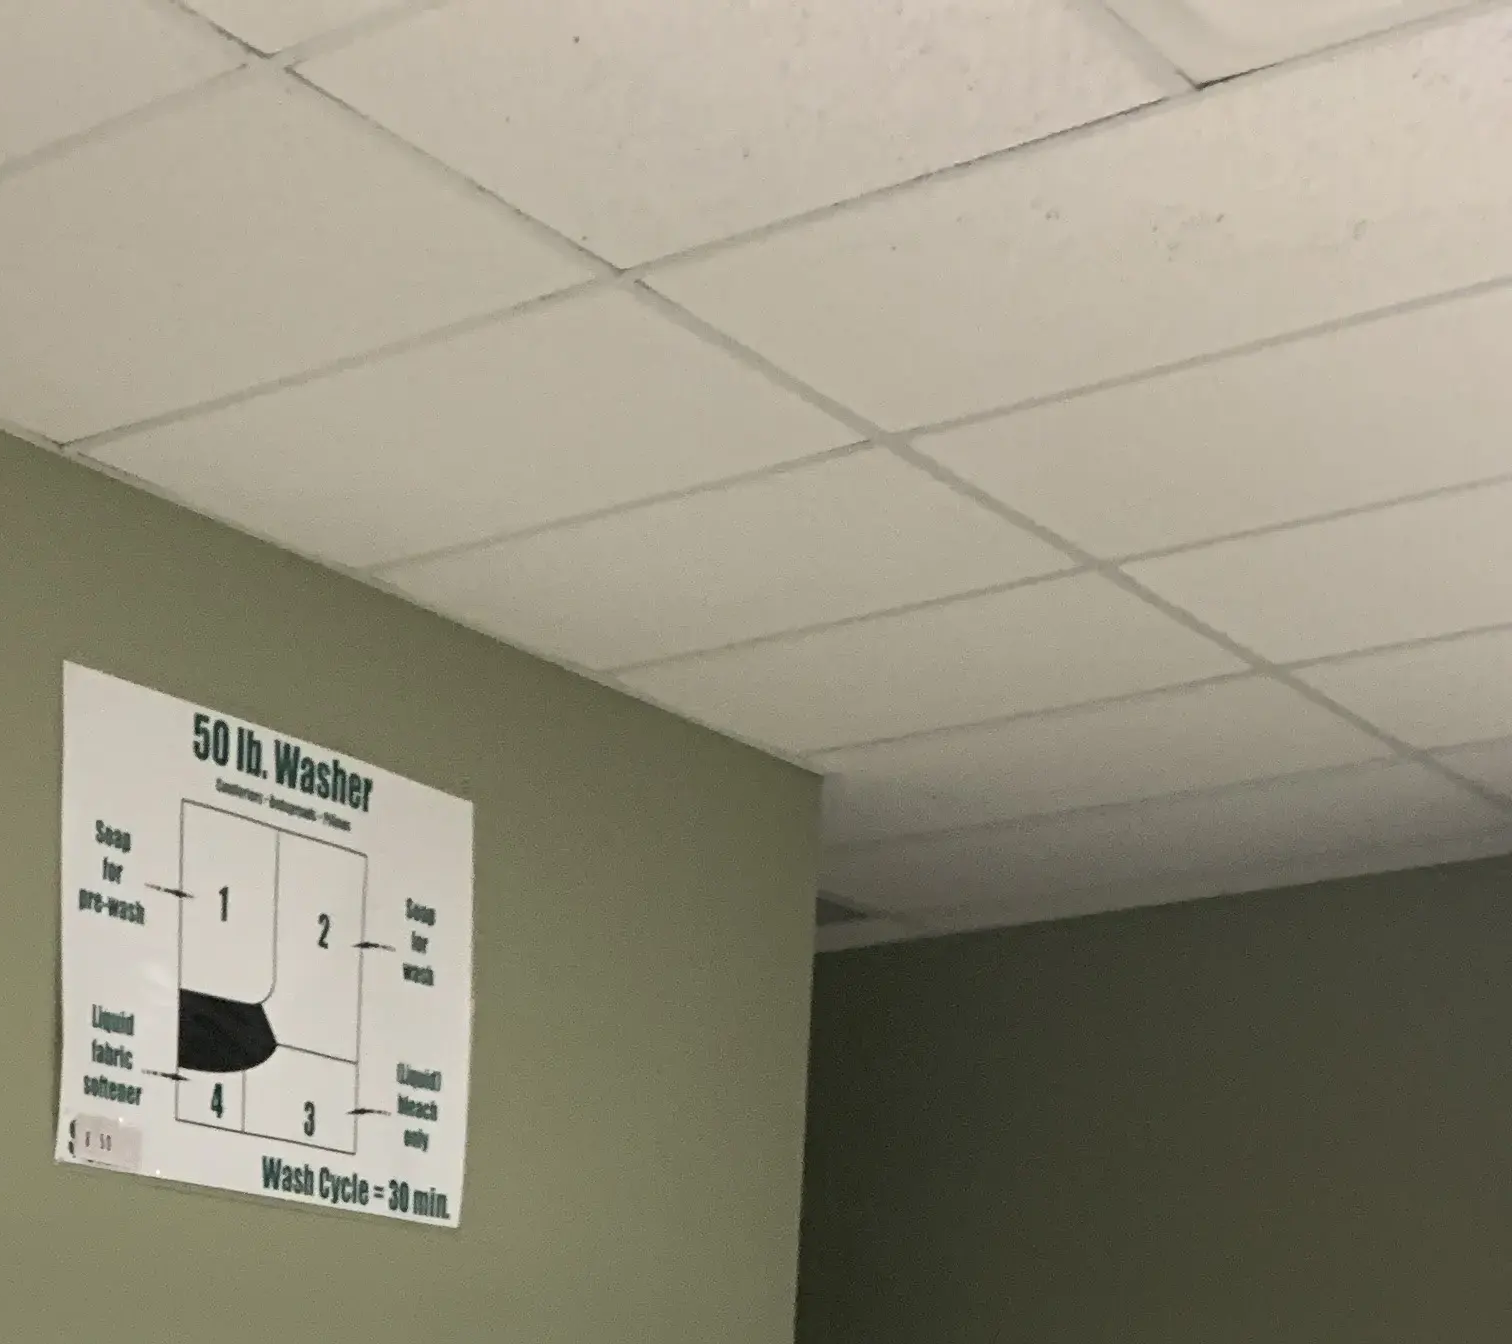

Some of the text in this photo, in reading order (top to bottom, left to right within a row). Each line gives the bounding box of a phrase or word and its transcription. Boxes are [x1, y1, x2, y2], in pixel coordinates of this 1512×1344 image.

[193, 712, 229, 766] 50
[237, 727, 268, 779] lb.
[275, 739, 373, 812] Washer
[95, 820, 131, 853] Soap
[103, 857, 123, 884] for
[79, 888, 145, 925] pre-wash
[219, 886, 229, 922] 1
[317, 913, 331, 949] 2
[92, 1004, 134, 1036] Liquid
[91, 1039, 133, 1070] fabric
[83, 1074, 142, 1105] softener
[211, 1082, 223, 1118] 4
[304, 1101, 315, 1136] 3
[262, 1155, 450, 1219] Wash Cycle = 30 min.
